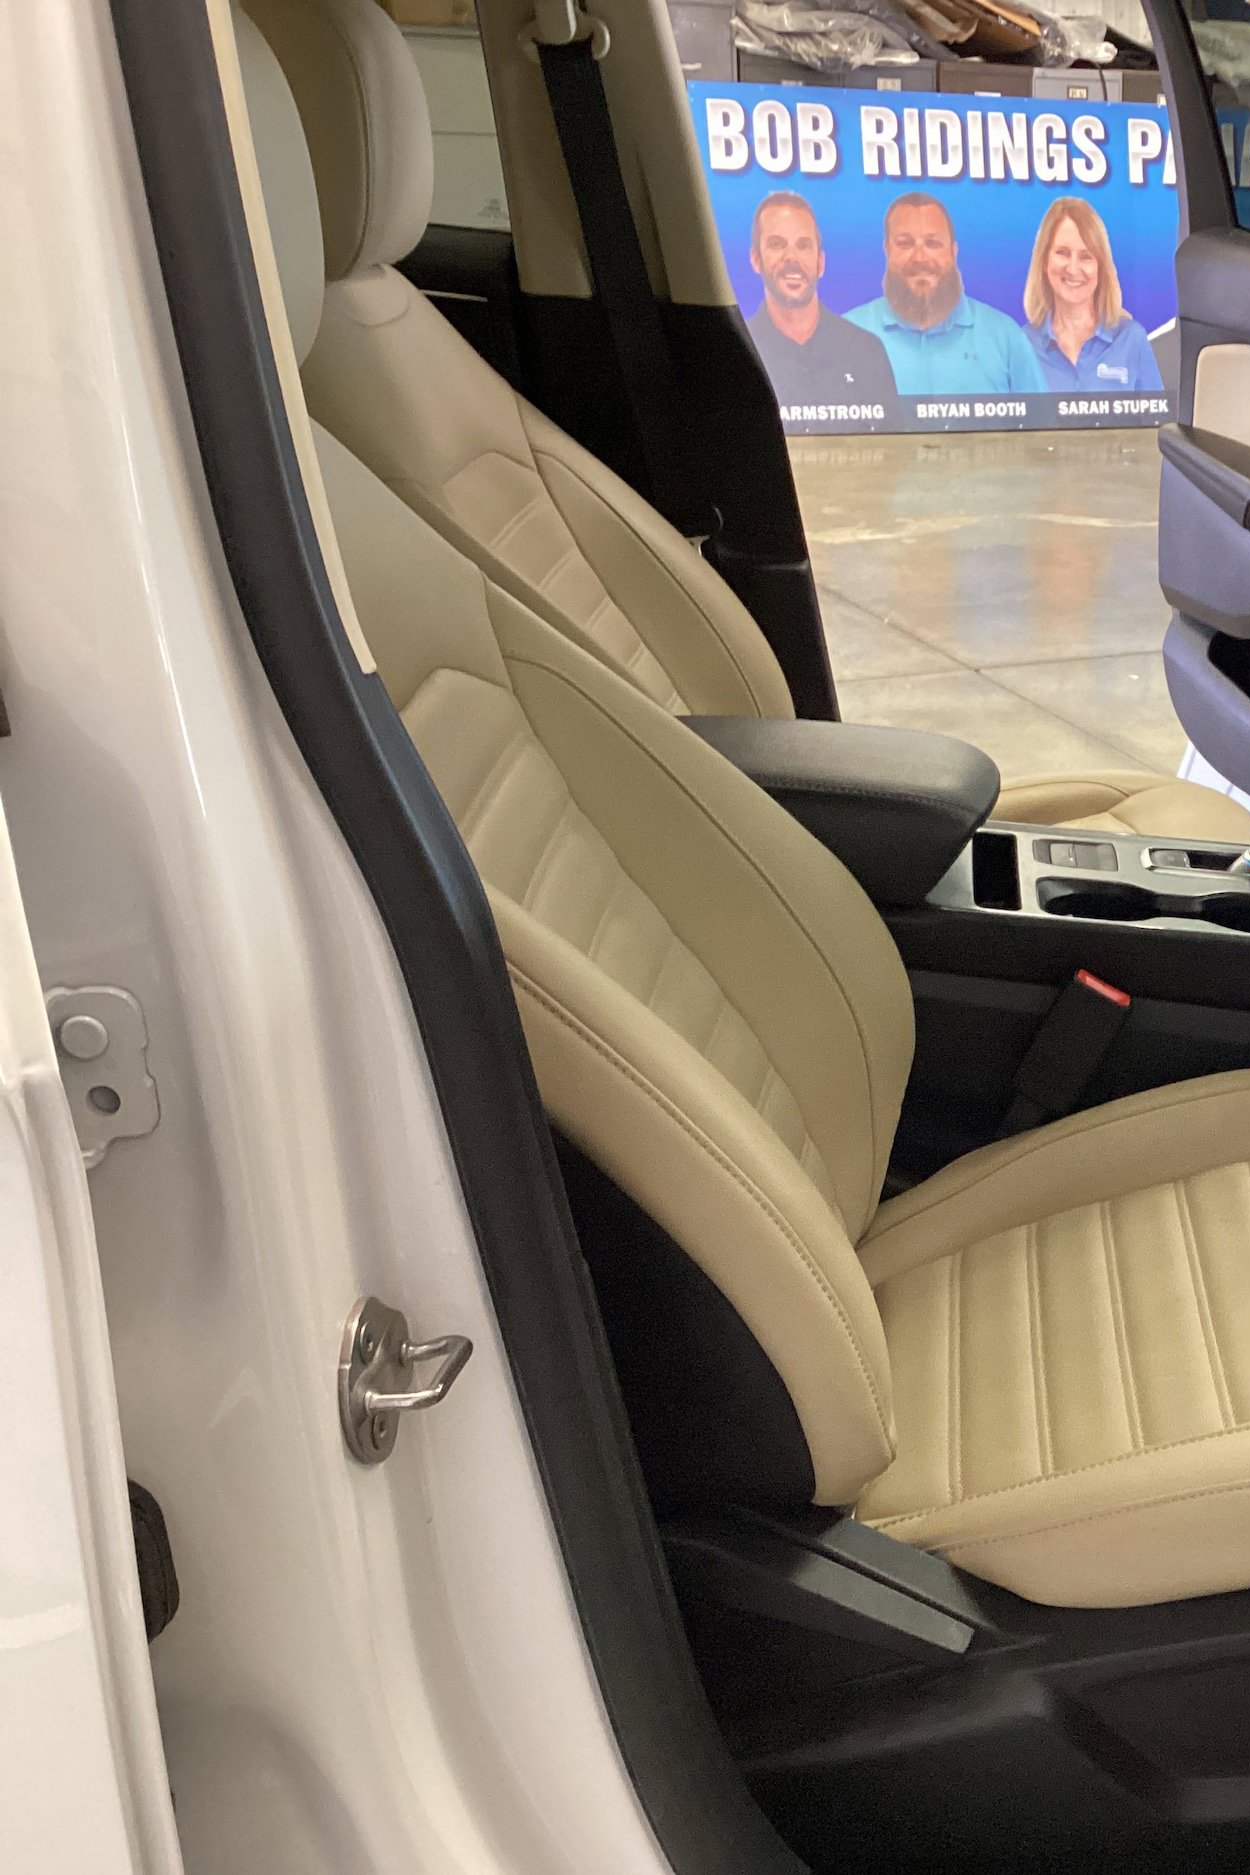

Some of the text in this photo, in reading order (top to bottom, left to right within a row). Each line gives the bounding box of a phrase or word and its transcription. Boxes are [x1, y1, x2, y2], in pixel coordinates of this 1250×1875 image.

[705, 97, 838, 174] BOB
[860, 104, 1109, 184] RIDINGS
[780, 404, 885, 421] ARMSTRONG
[916, 402, 1027, 419] BRYAN BOOTH
[1058, 399, 1169, 415] SARAH STUPEK
